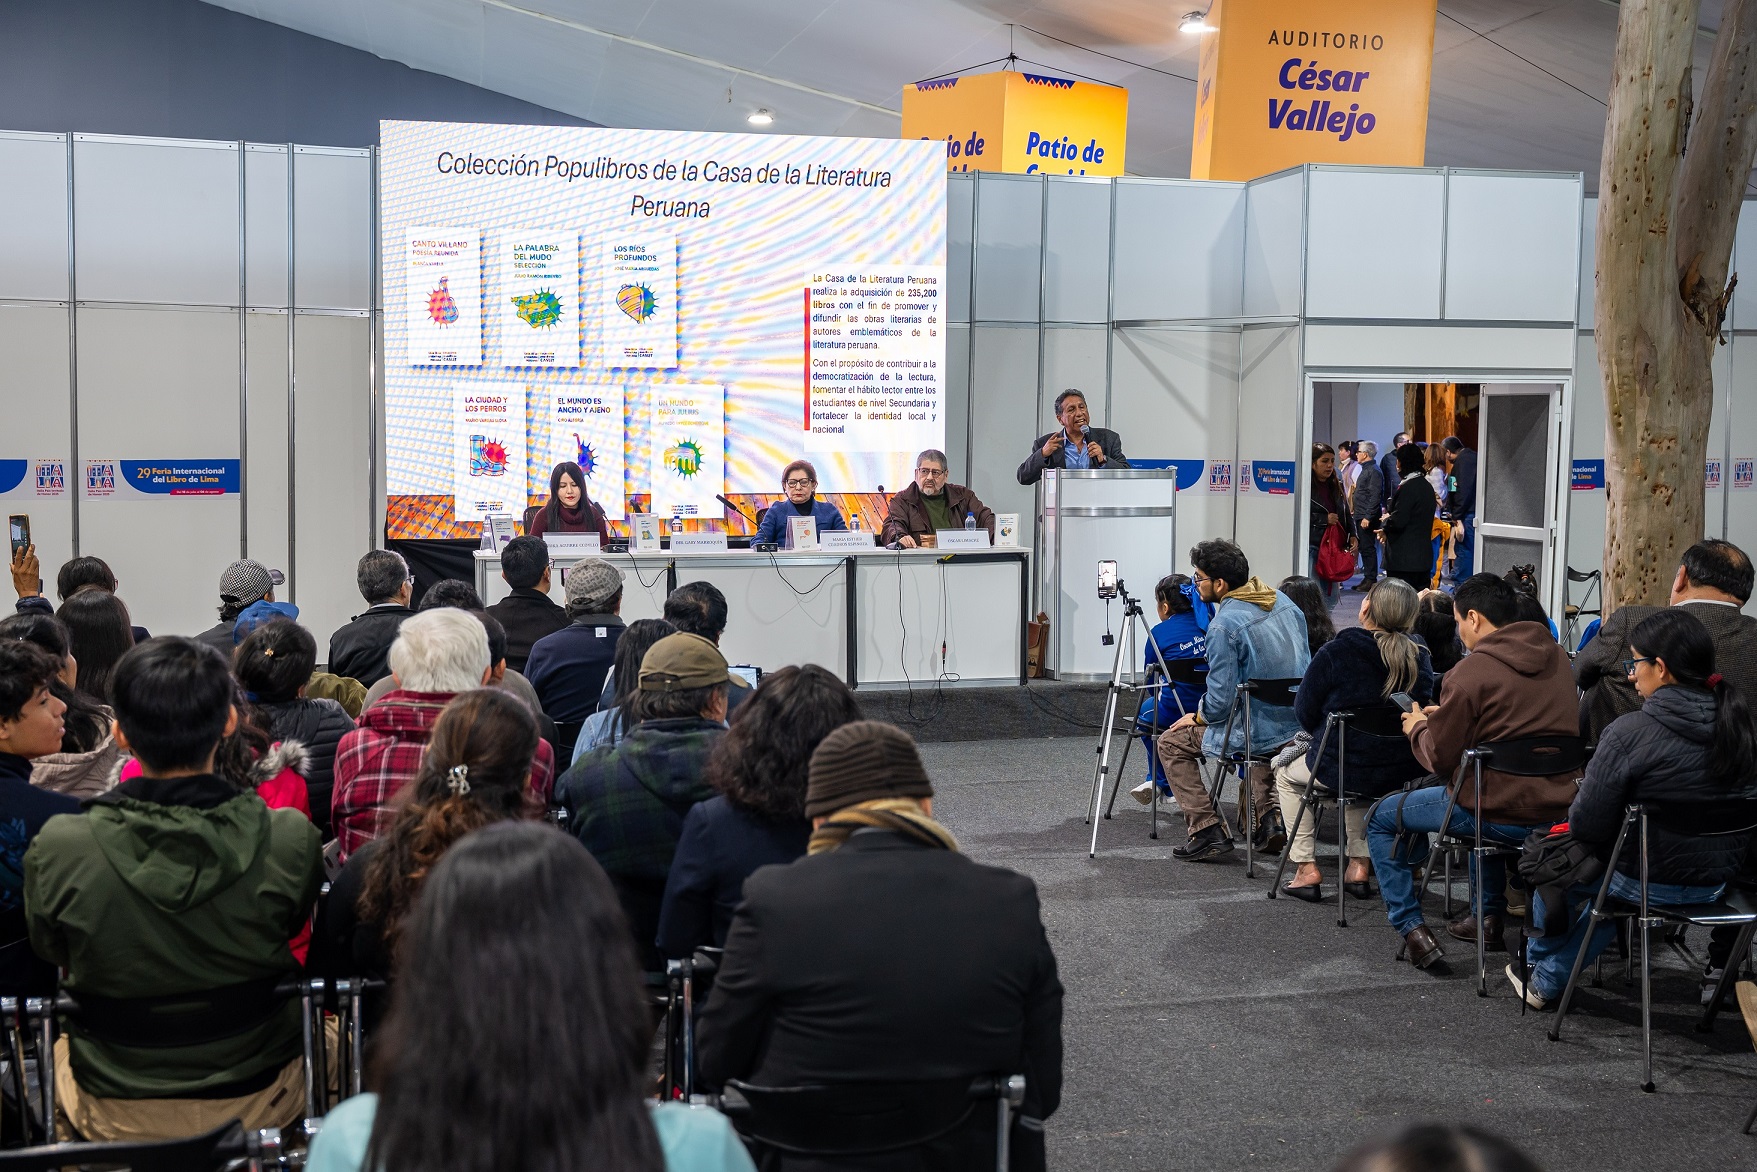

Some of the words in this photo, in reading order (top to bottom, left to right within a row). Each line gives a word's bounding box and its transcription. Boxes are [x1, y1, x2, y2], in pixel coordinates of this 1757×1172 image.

[1268, 29, 1384, 51] AUDITORIO
[1278, 58, 1370, 92] César
[1268, 98, 1376, 142] Vallejo
[964, 131, 985, 157] de
[1026, 132, 1078, 161] Patio
[1082, 139, 1105, 164] de
[438, 152, 539, 176] Colección
[544, 155, 648, 182] Populibros
[653, 159, 676, 181] de
[682, 160, 698, 182] la
[703, 160, 752, 183] Casa
[756, 163, 780, 184] de
[785, 164, 801, 185] la
[806, 164, 891, 188] Literatura
[630, 194, 710, 218] Peruana
[438, 240, 468, 248] VILLANO
[813, 274, 822, 282] La
[825, 274, 844, 283] Casa
[847, 274, 857, 283] de
[860, 275, 867, 283] la
[870, 275, 904, 284] Literatura
[907, 275, 937, 284] Peruana
[813, 287, 838, 296] realiza
[840, 288, 847, 296] la
[850, 288, 892, 297] adquisición
[896, 289, 905, 297] de
[908, 289, 937, 298] 235,200
[813, 301, 835, 309] libros
[857, 301, 864, 309] el
[868, 301, 877, 310] fin
[881, 302, 891, 310] de
[895, 303, 929, 311] promover
[932, 304, 937, 312] y
[813, 314, 841, 323] difundir
[848, 314, 858, 323] las
[864, 314, 884, 323] obras
[891, 315, 922, 323] literarias
[928, 316, 937, 324] de
[850, 327, 902, 336] emblemáticos
[912, 328, 920, 337] de
[930, 328, 936, 337] la
[813, 340, 846, 349] literatura
[848, 342, 880, 350] peruana.
[812, 359, 828, 367] Con
[830, 359, 837, 367] el
[838, 359, 874, 369] propósito
[875, 359, 884, 368] de
[886, 359, 921, 368] contribuir
[930, 360, 936, 368] la
[812, 372, 874, 381] democratización
[880, 372, 889, 380] de
[896, 373, 902, 381] la
[908, 373, 936, 382] lectura,
[812, 385, 846, 394] fomentar
[848, 386, 855, 394] el
[857, 385, 880, 394] hábito
[882, 386, 902, 394] lector
[926, 386, 936, 394] los
[812, 398, 856, 407] estudiantes
[858, 399, 867, 407] de
[870, 399, 886, 407] nivel
[889, 399, 929, 407] Secundaria
[932, 400, 936, 409] y
[812, 412, 848, 420] fortalecer
[868, 412, 901, 420] identidad
[908, 412, 926, 420] local
[812, 425, 844, 433] nacional
[137, 468, 150, 478] 29
